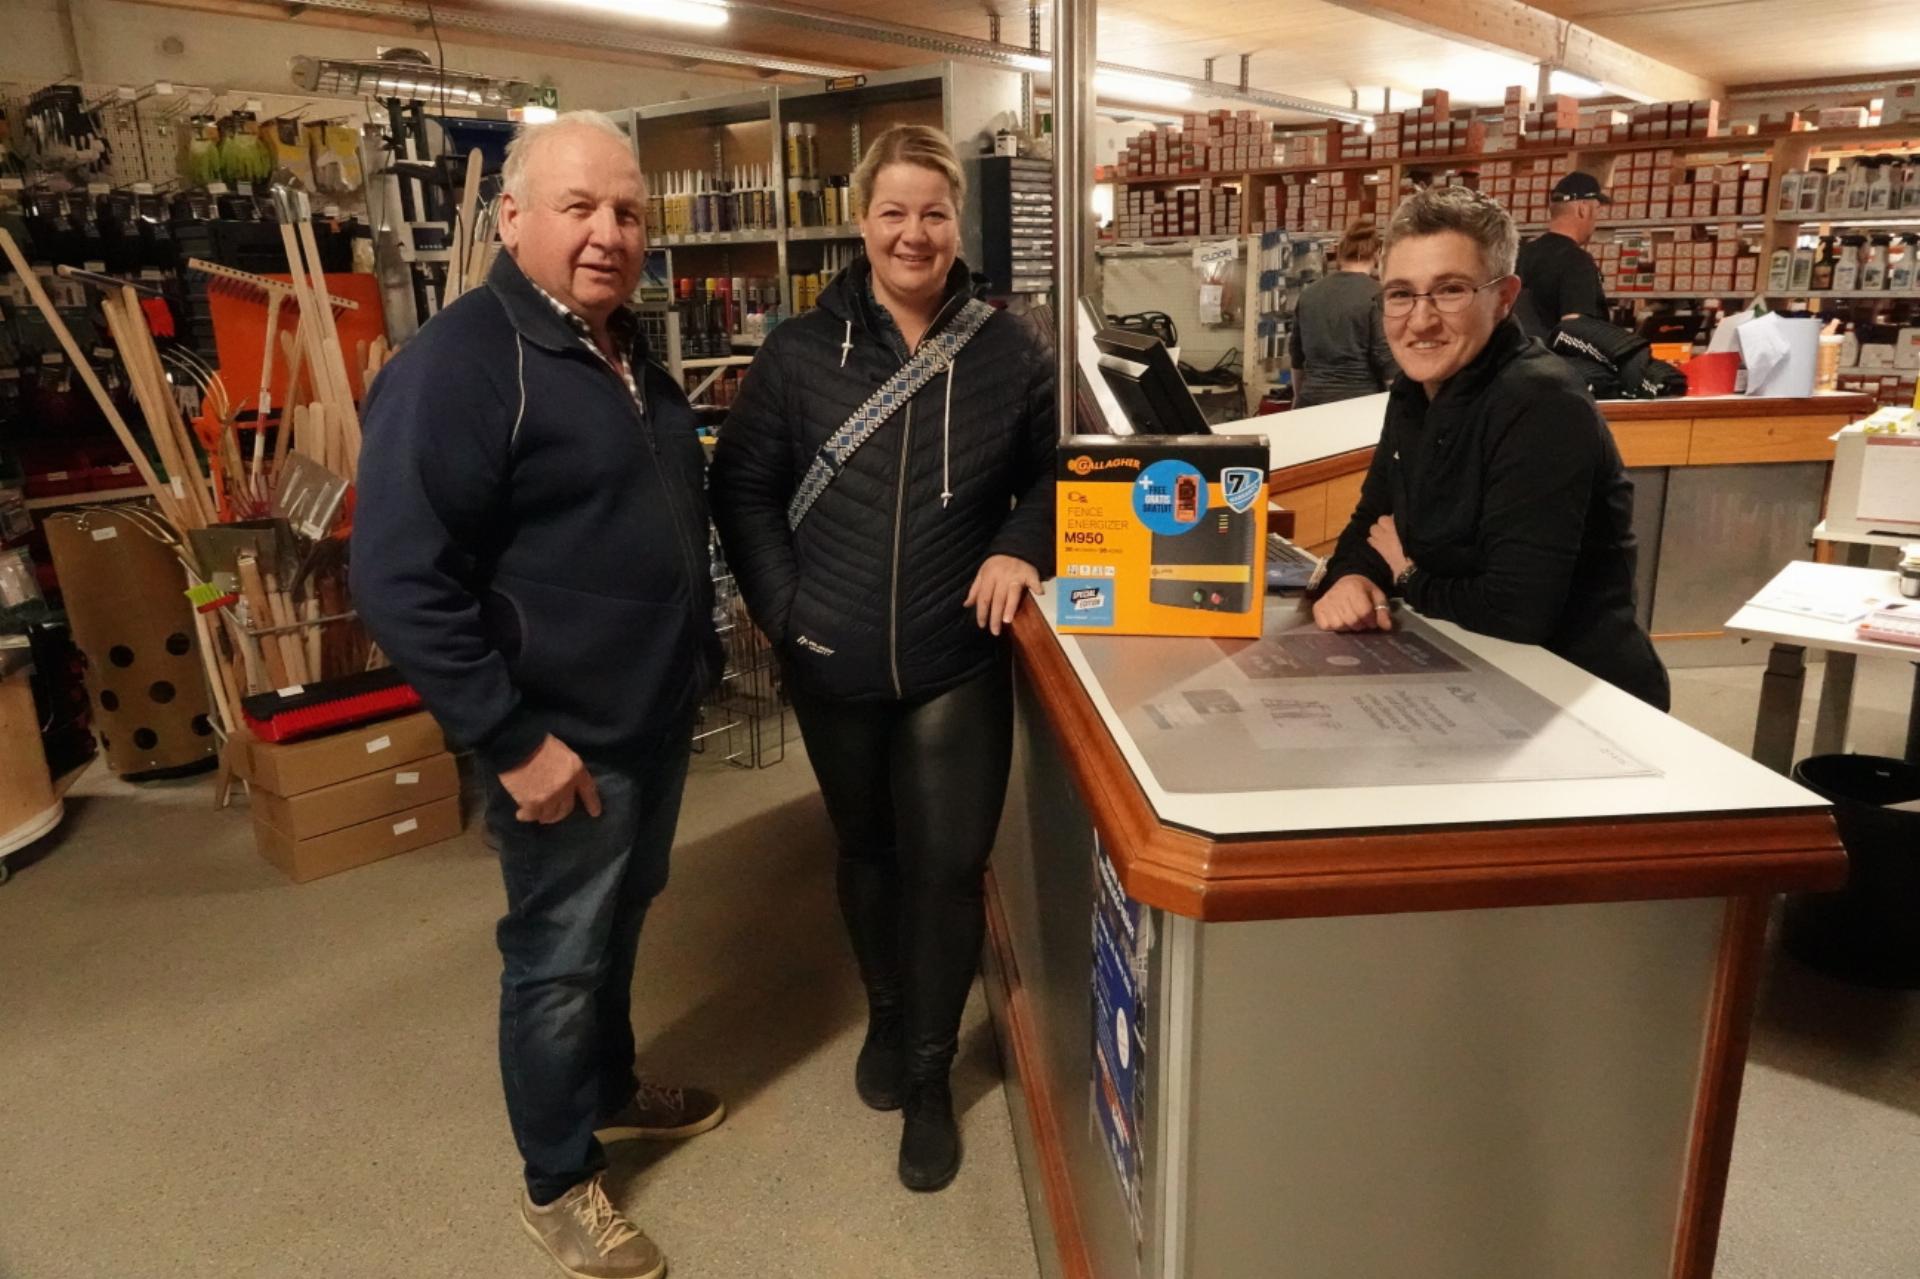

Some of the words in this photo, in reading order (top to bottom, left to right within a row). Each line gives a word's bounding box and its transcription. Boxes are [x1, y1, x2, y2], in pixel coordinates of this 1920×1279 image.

[1074, 456, 1140, 474] GALLAGHER
[1228, 474, 1245, 493] 7
[1149, 486, 1166, 494] FREE
[1067, 507, 1103, 517] FENCE
[1067, 520, 1129, 530] ENERGIZER
[1065, 532, 1104, 544] M950
